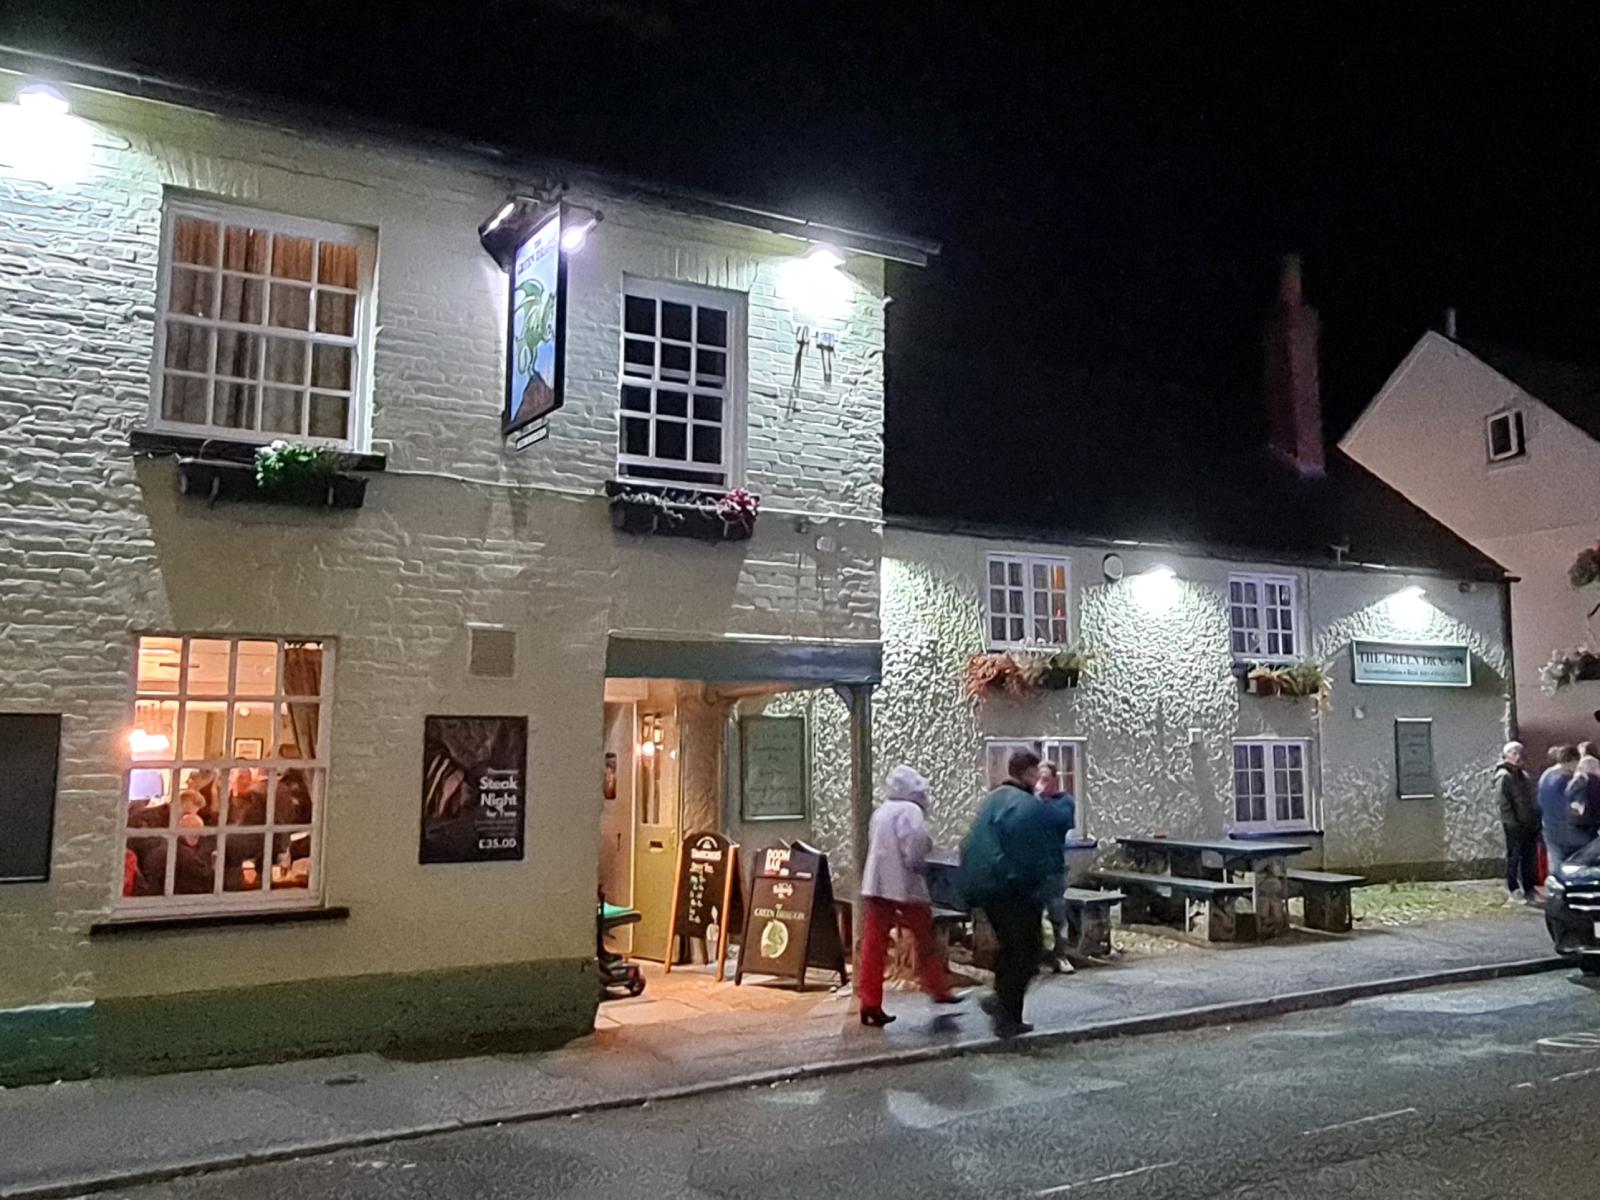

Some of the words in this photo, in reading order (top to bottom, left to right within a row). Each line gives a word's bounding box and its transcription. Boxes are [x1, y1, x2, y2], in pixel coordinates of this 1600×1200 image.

[1360, 651, 1381, 664] THE
[1384, 652, 1420, 665] GREEN
[479, 775, 518, 790] Steak
[480, 792, 518, 816] Night
[767, 848, 791, 861] DOOM
